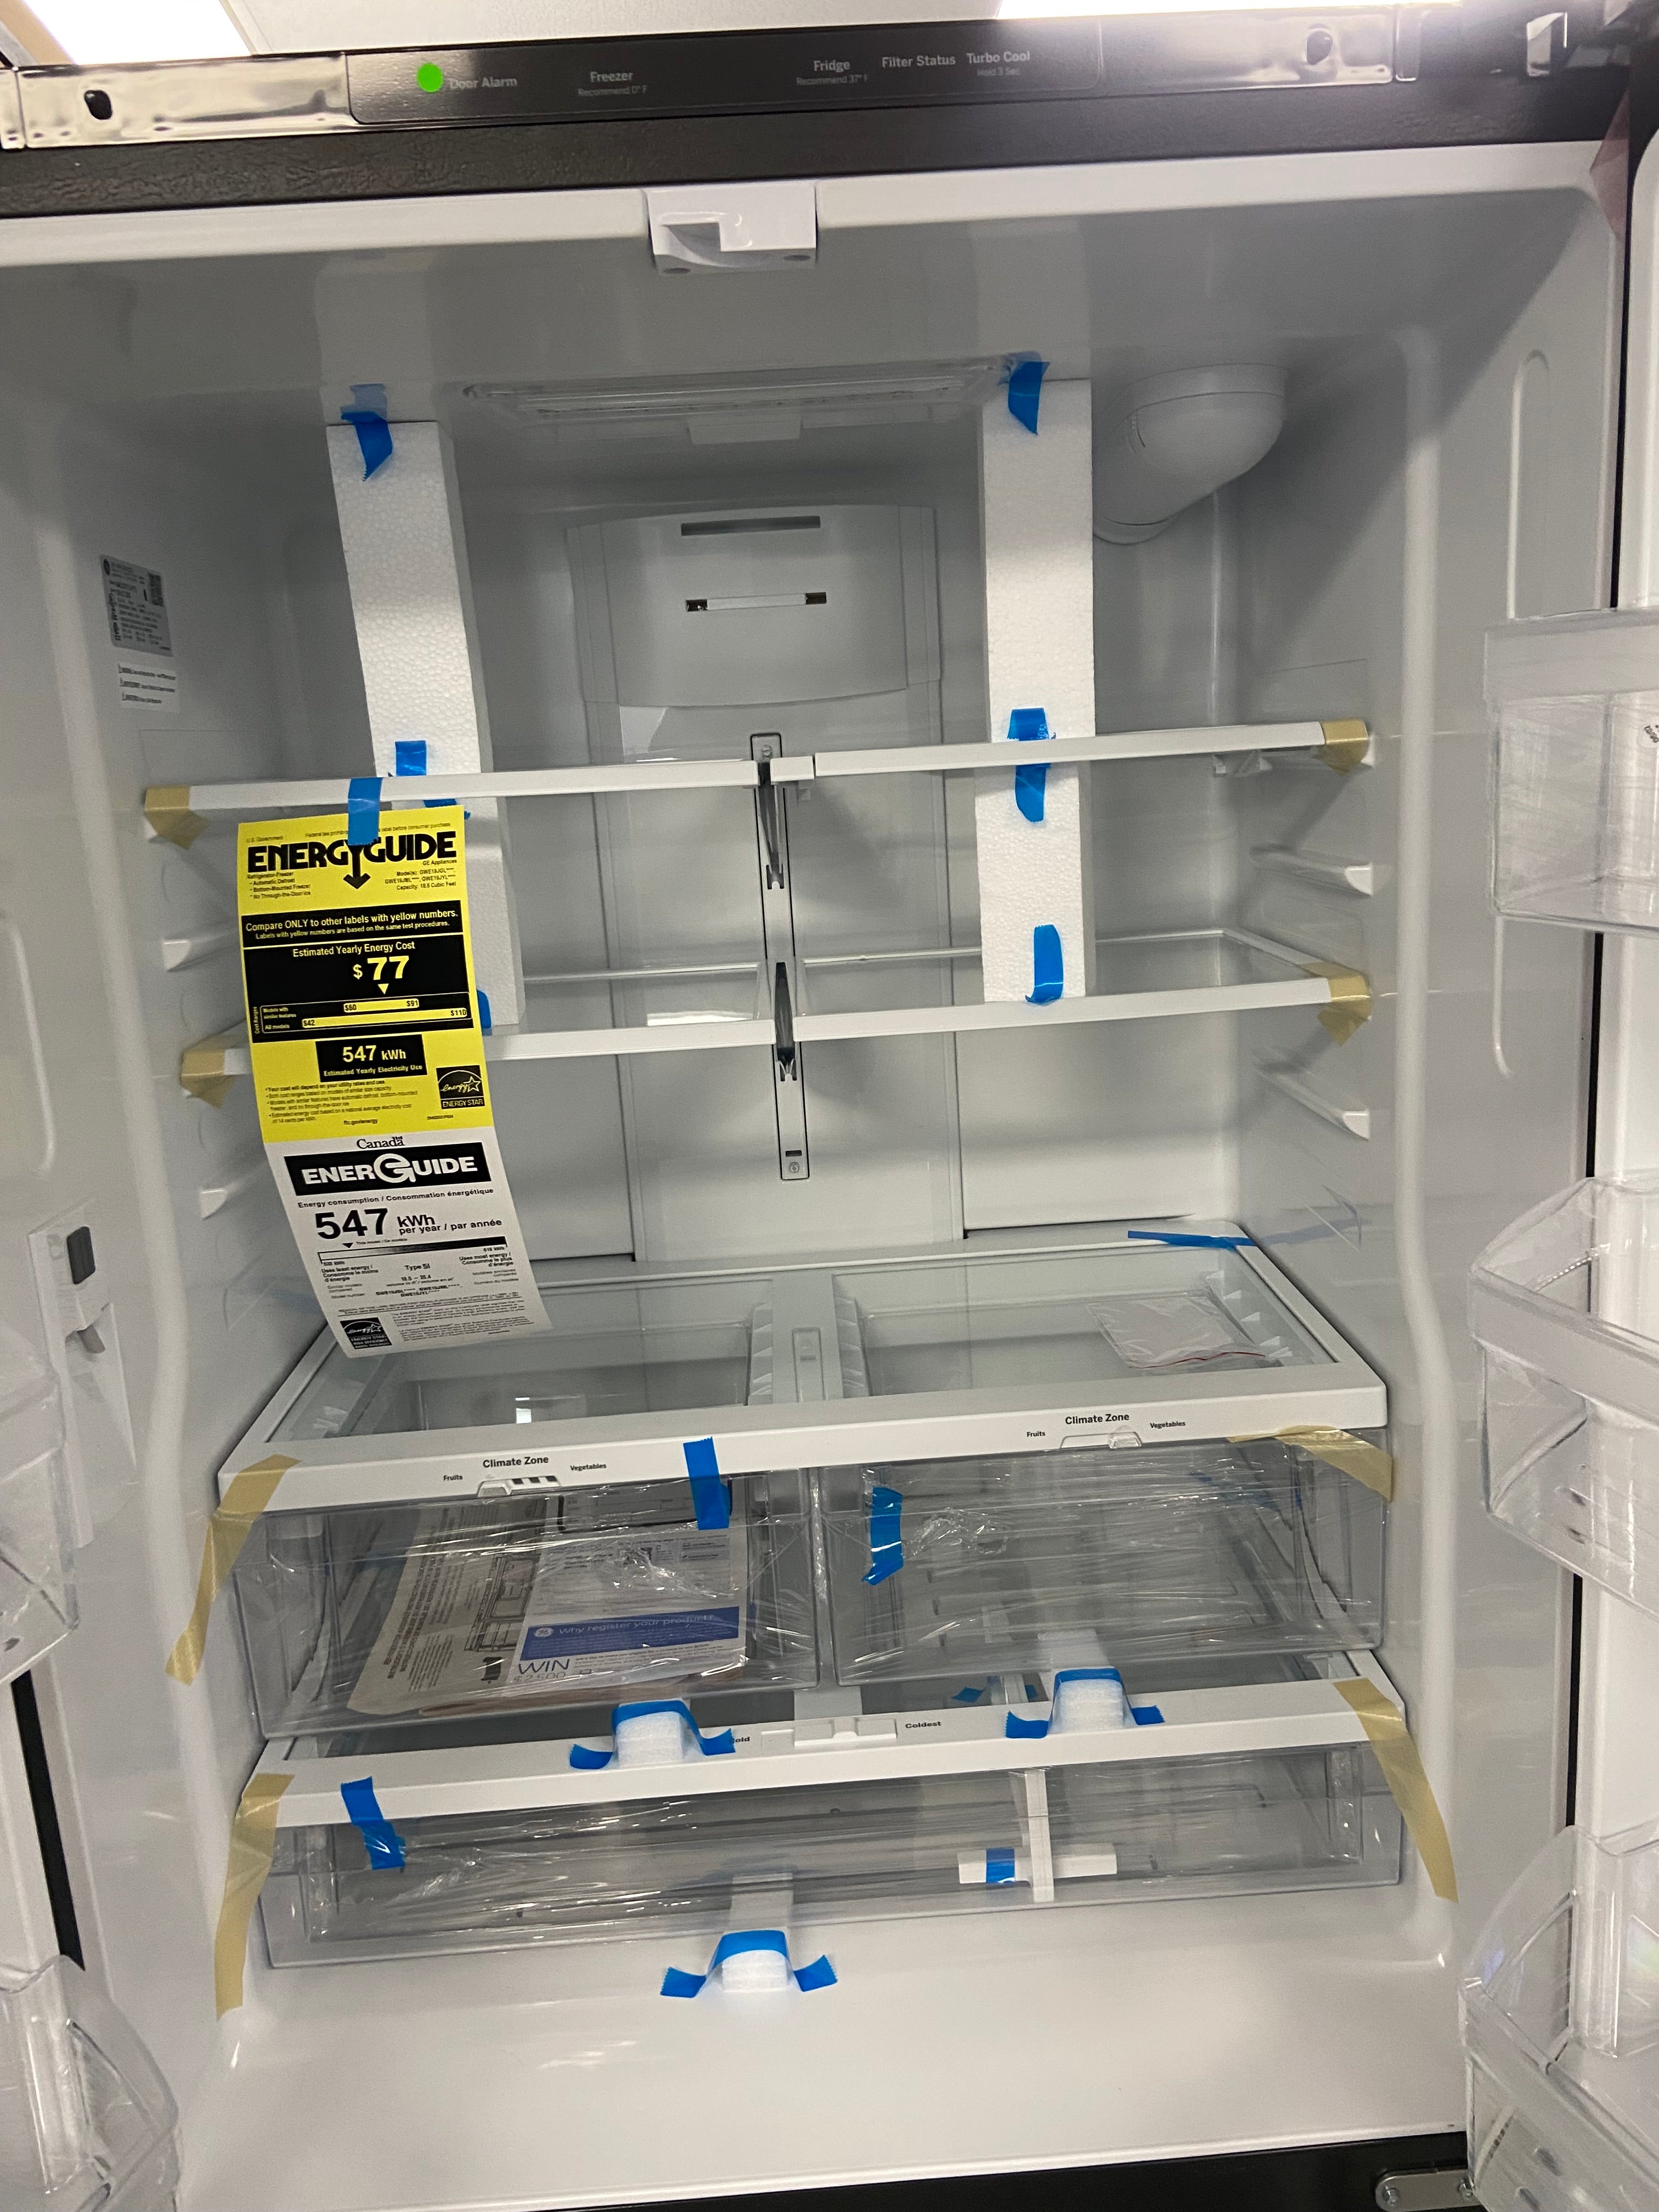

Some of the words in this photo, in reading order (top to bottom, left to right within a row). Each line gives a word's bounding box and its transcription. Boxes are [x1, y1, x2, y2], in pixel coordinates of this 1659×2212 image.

[882, 56, 913, 67] Filter
[917, 55, 956, 66] Status
[966, 52, 1000, 64] Turbo
[1003, 51, 1030, 62] Cool
[814, 60, 850, 72] Fridge
[448, 77, 478, 89] Door
[481, 77, 517, 87] Alarm
[590, 71, 633, 82] Freezer
[246, 922, 283, 933] Compare
[285, 919, 308, 929] ONLY
[311, 918, 318, 927] to
[320, 917, 342, 926] other
[344, 915, 369, 924] labels
[371, 913, 388, 922] with
[391, 911, 416, 923] yellow
[419, 909, 458, 919] numbers.
[289, 929, 308, 938] yellow
[309, 928, 335, 936] numbers
[415, 920, 450, 929] procedures.
[293, 946, 334, 957] Estimated
[336, 945, 362, 956] Yearly
[364, 943, 393, 954] Energy
[396, 941, 415, 951] Cost
[353, 964, 363, 980] $
[368, 955, 409, 981] 77
[407, 999, 418, 1007] $91
[450, 1008, 467, 1017] $110
[342, 1045, 377, 1063] 547
[381, 1049, 406, 1060] kWh
[324, 1069, 354, 1077] Estimated
[356, 1067, 376, 1075] Yearly
[378, 1065, 409, 1074] Electricity
[357, 1136, 405, 1149] Canada
[301, 1153, 478, 1184] ENERGUIDE
[298, 1200, 326, 1209] Energy
[328, 1197, 380, 1206] consumption
[386, 1191, 445, 1201] Consommation
[447, 1188, 494, 1197] énergétique
[315, 1208, 388, 1239] 547
[397, 1214, 436, 1228] kWh
[399, 1226, 416, 1235] per
[420, 1223, 441, 1234] year
[444, 1223, 448, 1231] /
[451, 1222, 467, 1231] par
[470, 1218, 503, 1228] année
[1065, 1414, 1103, 1425] Climate
[1105, 1413, 1130, 1422] Zone
[1150, 1420, 1186, 1429] Vegetables
[483, 1457, 522, 1468] Climate
[524, 1455, 549, 1465] Zone
[571, 1463, 607, 1471] Vegetables
[560, 1626, 584, 1634] Why
[588, 1622, 631, 1632] register
[634, 1620, 659, 1628] your
[518, 1658, 570, 1674] WIN
[905, 1720, 941, 1729] Coldest
